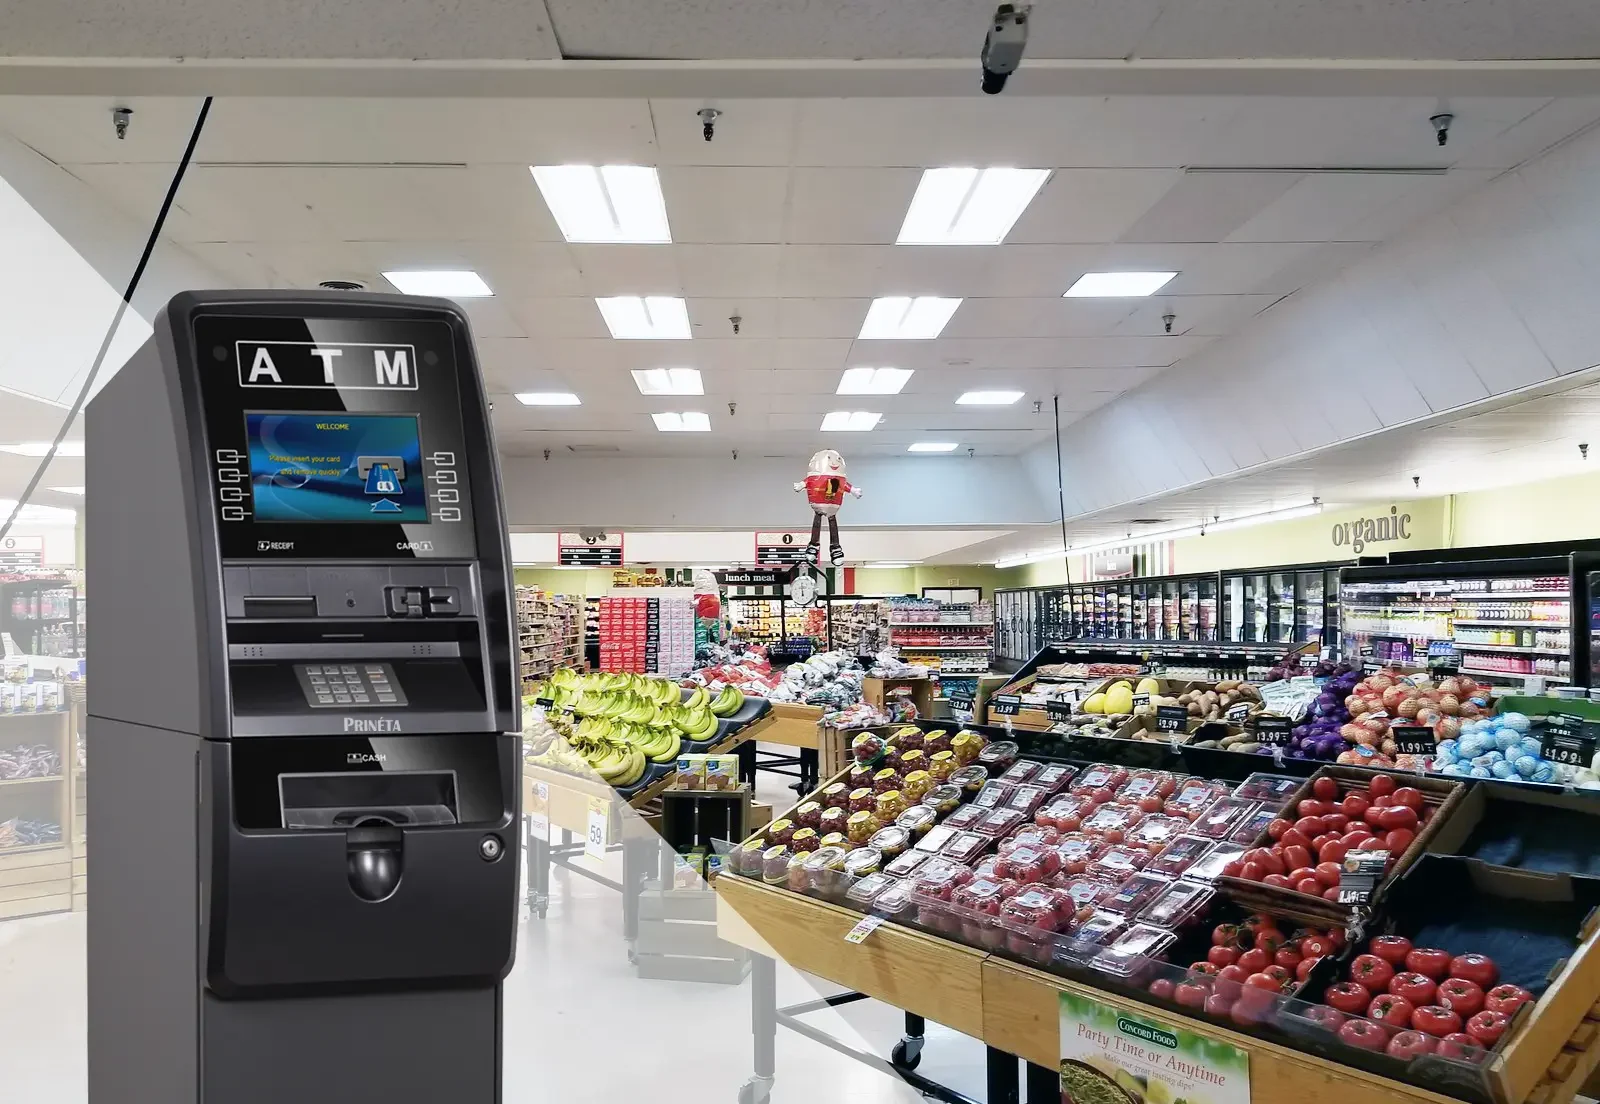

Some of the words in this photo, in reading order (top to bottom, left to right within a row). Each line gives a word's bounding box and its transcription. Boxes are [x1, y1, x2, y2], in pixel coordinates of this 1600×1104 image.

[269, 454, 291, 462] Please
[318, 468, 340, 476] quickly
[1331, 505, 1411, 554] organic
[271, 542, 294, 550] RECEIPT
[396, 542, 420, 550] CARD
[725, 573, 751, 581] lunch
[753, 574, 776, 582] meat
[362, 753, 387, 762] CASH
[1077, 1023, 1110, 1049] Party
[1114, 1035, 1144, 1058] Time
[1148, 1052, 1162, 1064] or
[1166, 1055, 1226, 1086] Anytime
[1103, 1052, 1121, 1064] Make
[1121, 1060, 1133, 1068] our
[1133, 1065, 1151, 1076] great
